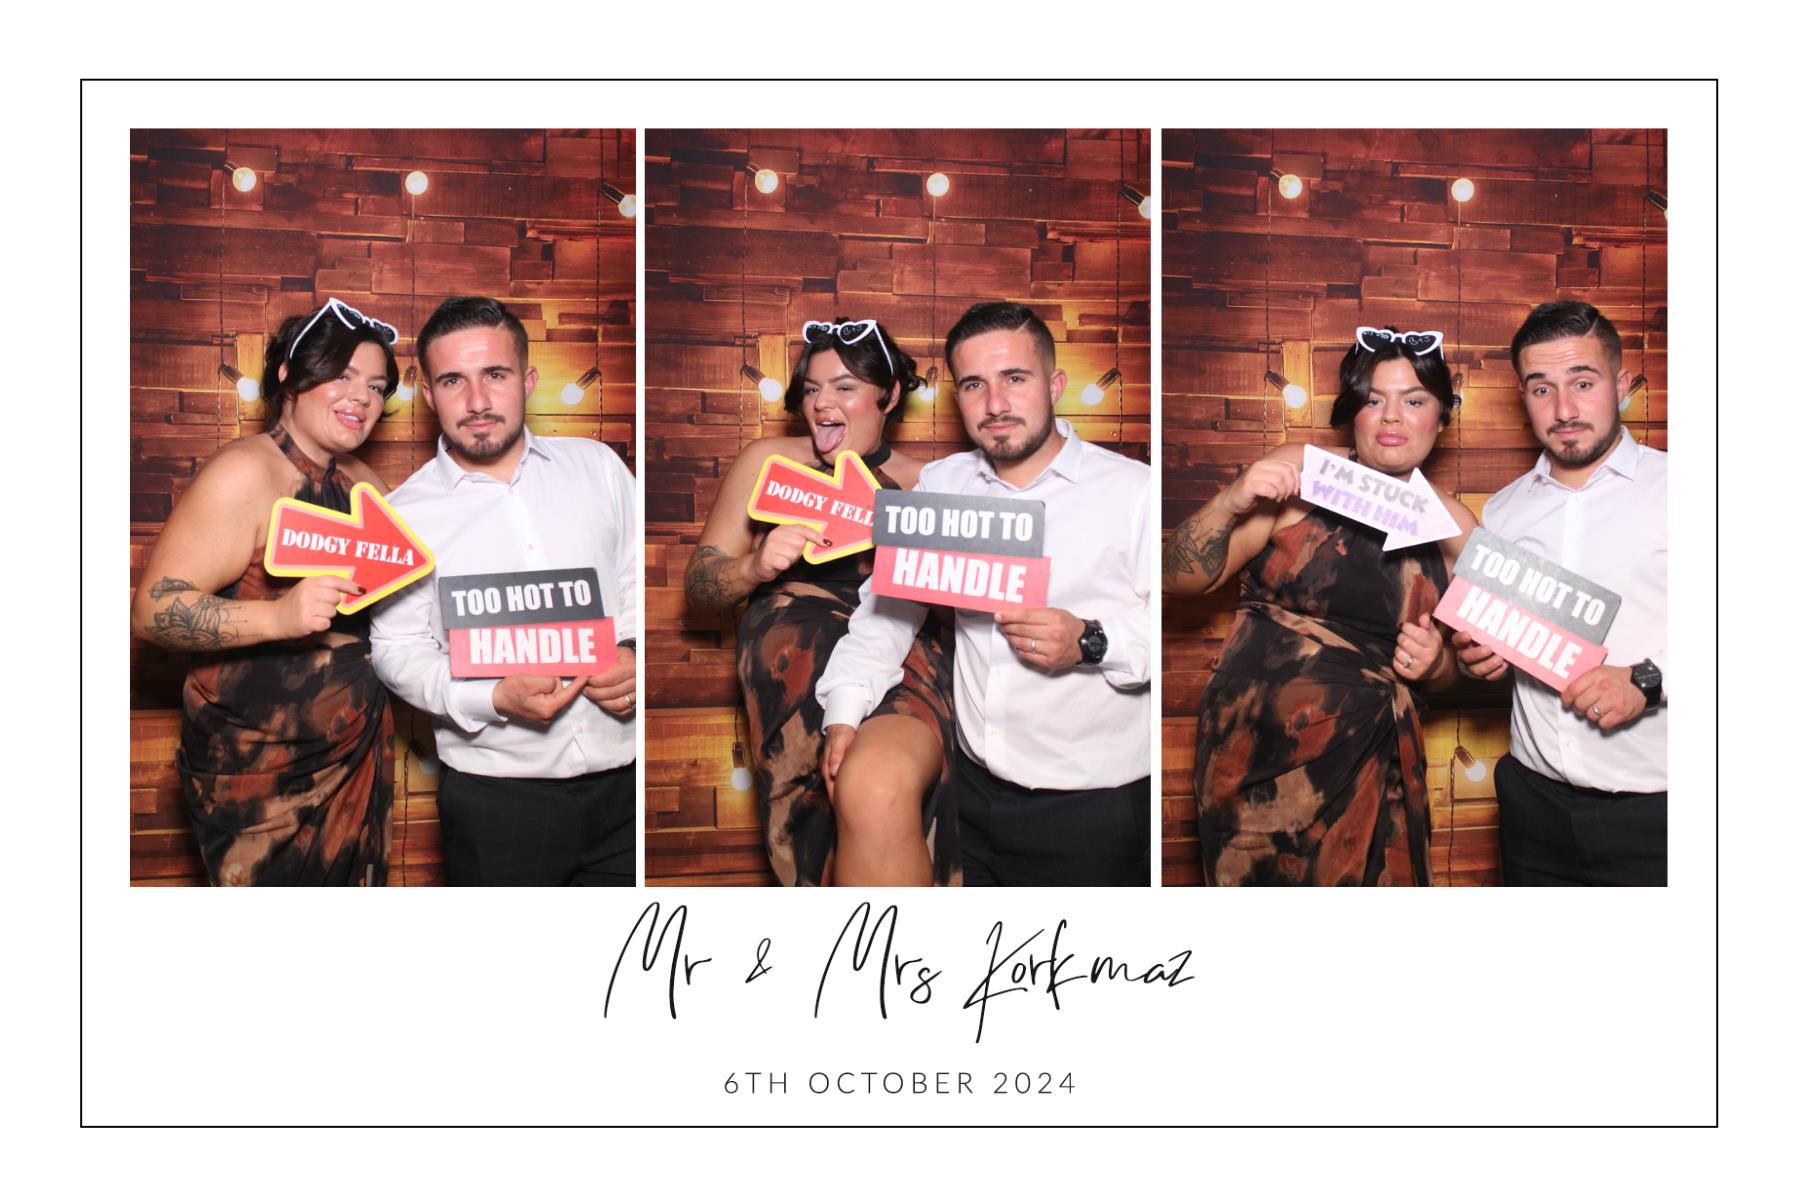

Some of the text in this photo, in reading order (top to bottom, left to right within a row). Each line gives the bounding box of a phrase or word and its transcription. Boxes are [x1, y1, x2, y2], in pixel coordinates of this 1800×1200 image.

[765, 480, 874, 527] DODGY FELL
[1312, 480, 1419, 537] WITH HIM
[1319, 459, 1429, 514] I'M STUCK
[281, 528, 415, 567] DODGY FELLA
[885, 505, 1034, 542] TOO HOT TO
[451, 580, 592, 616] TOO HOT TO
[892, 547, 1028, 604] HANDLE
[1471, 544, 1607, 626] TOO HOT TO
[469, 628, 597, 665] HANDLE
[1456, 586, 1584, 679] HANDLE
